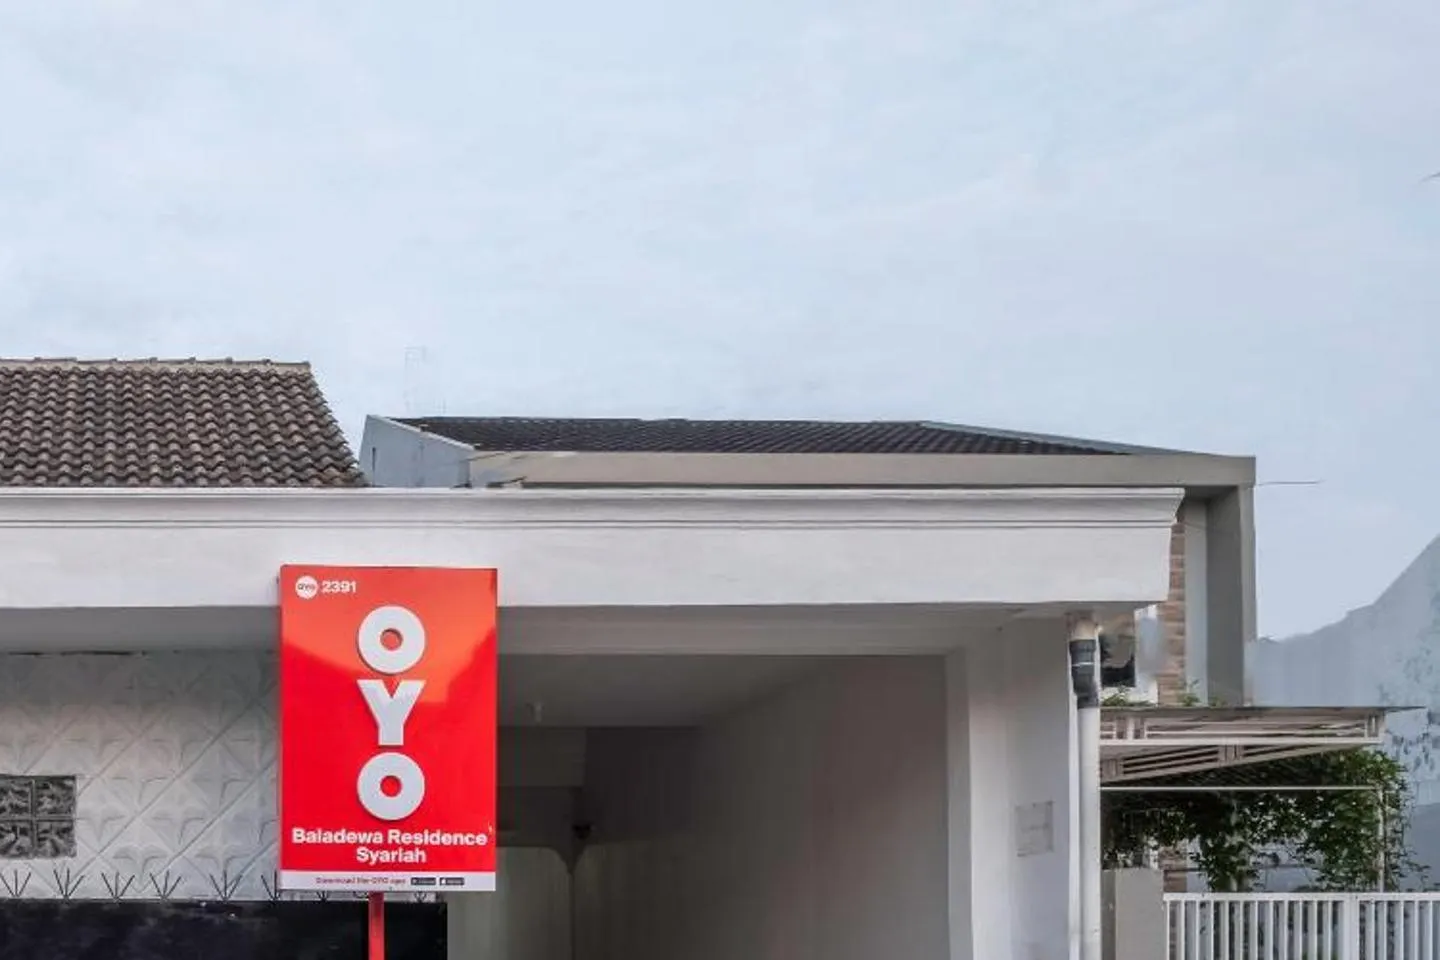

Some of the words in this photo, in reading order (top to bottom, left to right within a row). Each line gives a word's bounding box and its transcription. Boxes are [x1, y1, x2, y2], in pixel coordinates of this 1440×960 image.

[321, 580, 357, 593] 2391
[357, 605, 426, 821] OYO
[291, 827, 383, 844] Baladewa
[388, 829, 488, 846] Residence
[356, 846, 427, 865] Syariah
